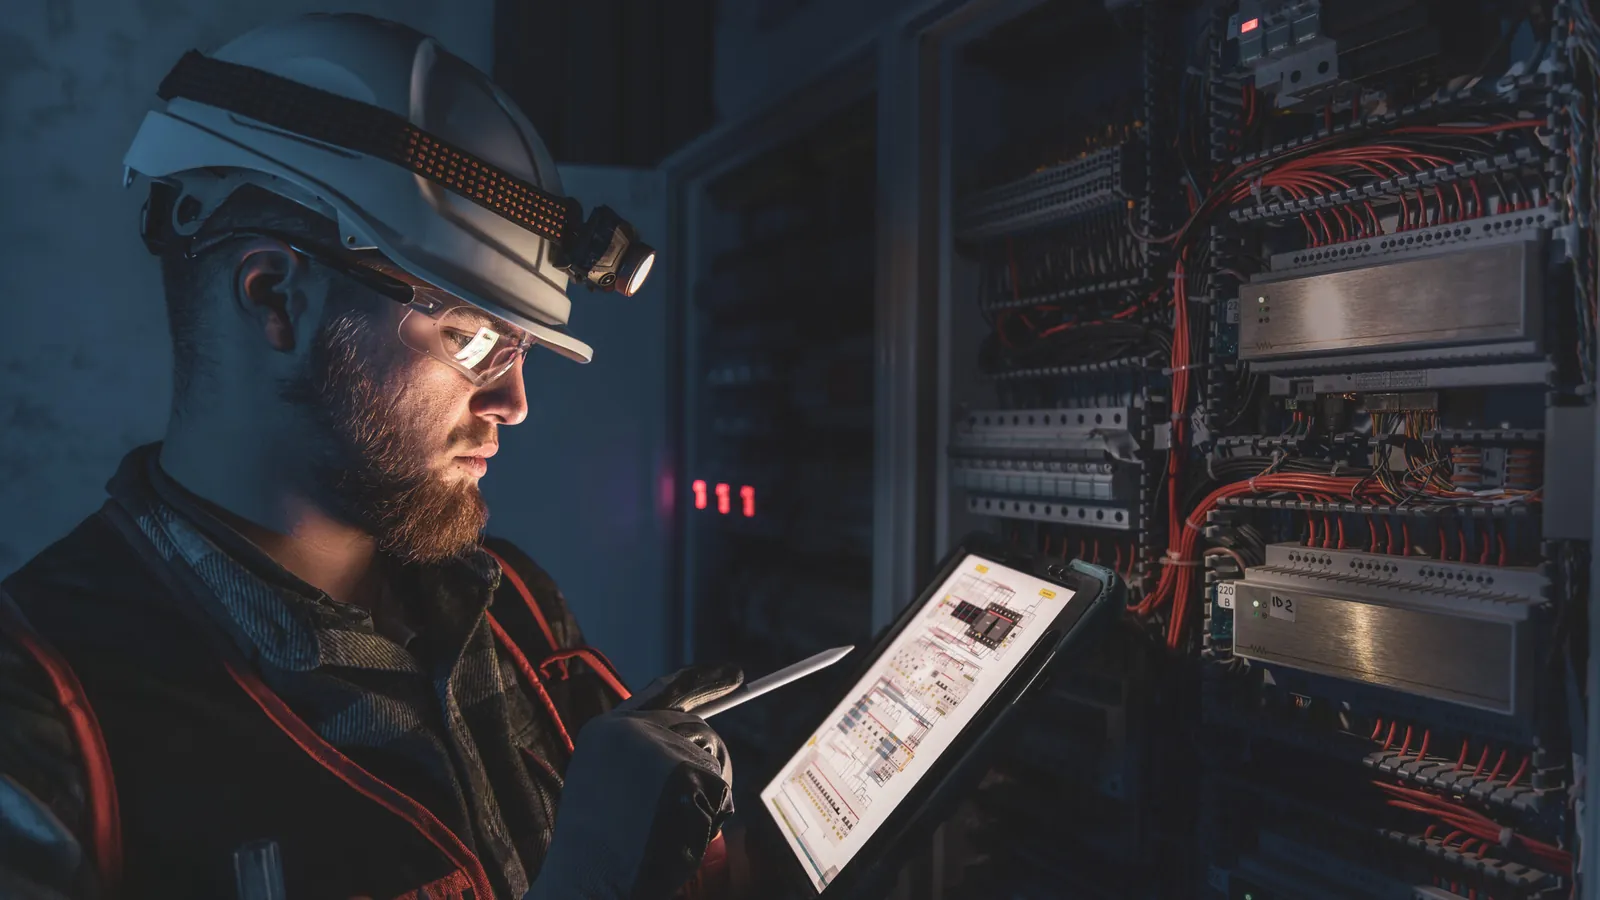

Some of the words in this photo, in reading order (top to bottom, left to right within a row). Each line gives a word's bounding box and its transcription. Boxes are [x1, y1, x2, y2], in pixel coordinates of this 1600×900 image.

[1219, 586, 1233, 595] 220
[1224, 598, 1230, 607] B
[1285, 599, 1293, 613] 2
